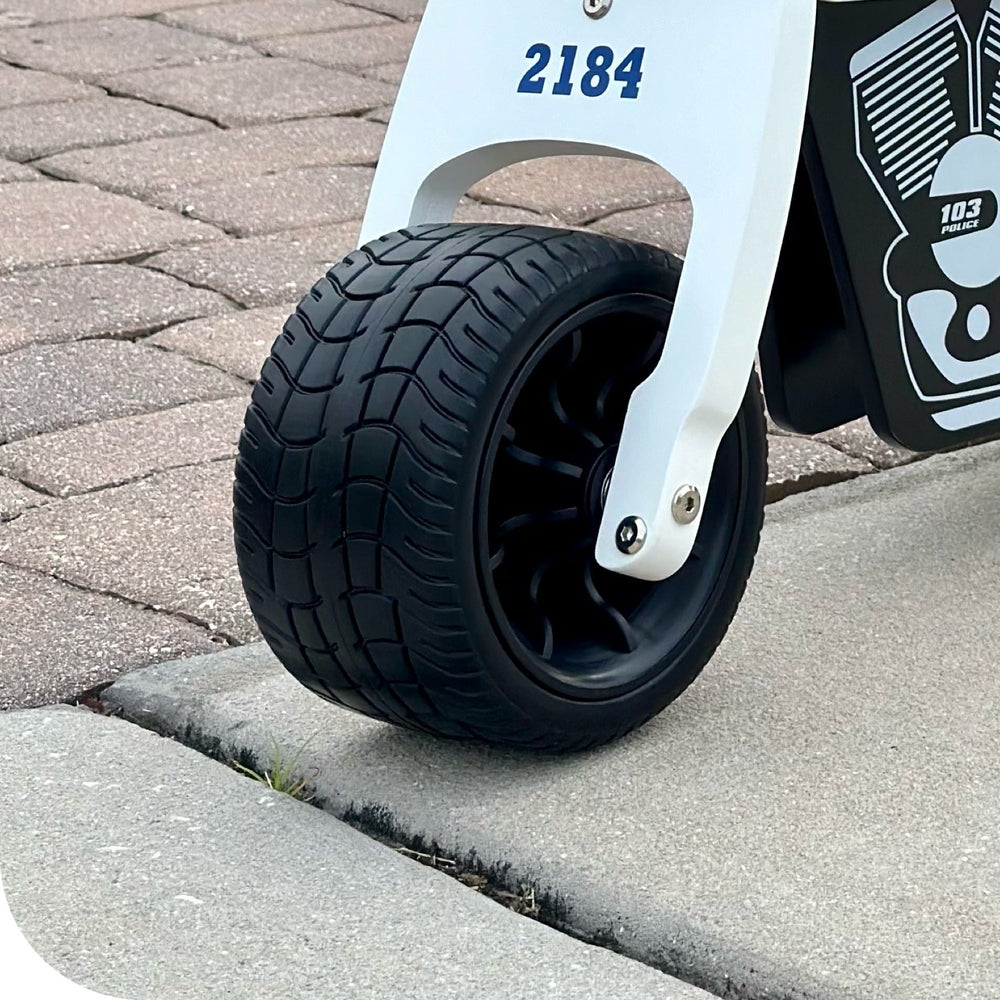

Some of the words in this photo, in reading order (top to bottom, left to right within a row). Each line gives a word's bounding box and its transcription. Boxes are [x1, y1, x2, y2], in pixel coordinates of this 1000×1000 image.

[516, 42, 646, 99] 2184
[941, 197, 982, 224] 103
[941, 219, 980, 235] POLICE
